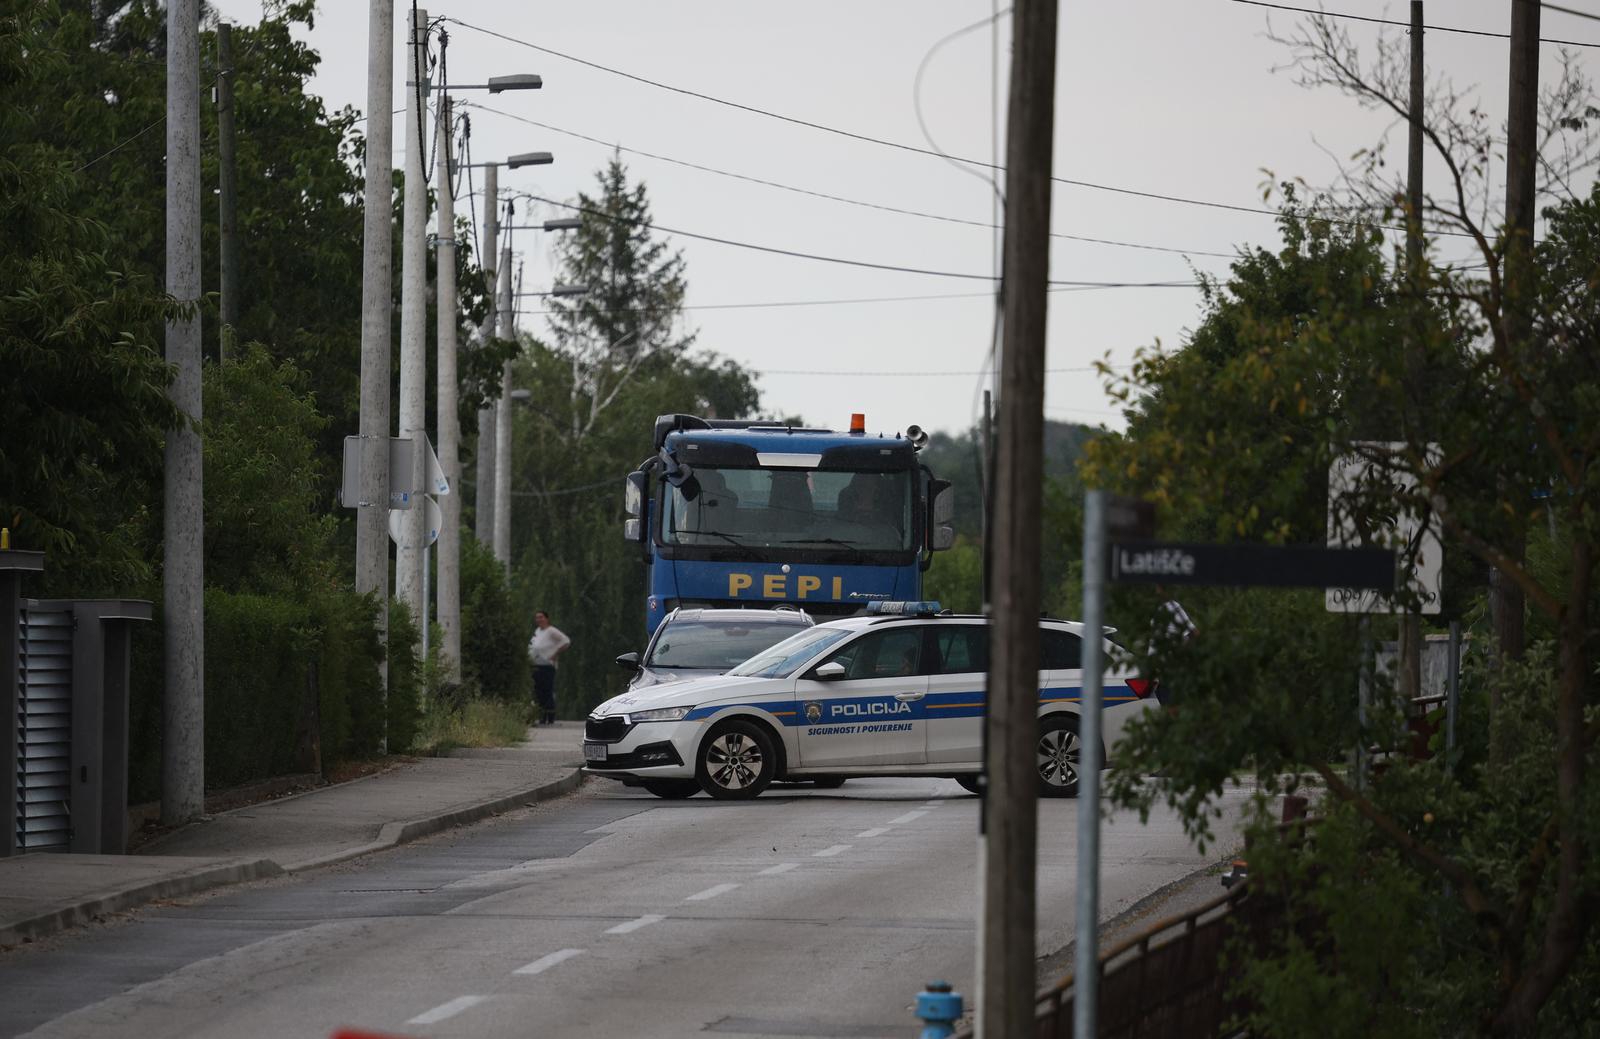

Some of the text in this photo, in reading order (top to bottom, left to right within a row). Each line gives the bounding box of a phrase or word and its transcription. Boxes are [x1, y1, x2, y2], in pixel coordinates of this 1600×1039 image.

[1120, 549, 1195, 575] Latišče
[728, 573, 842, 600] PEPI
[831, 702, 912, 717] POLICIJA
[808, 726, 855, 736] SIGURNOST
[862, 723, 913, 734] POVJERENJE
